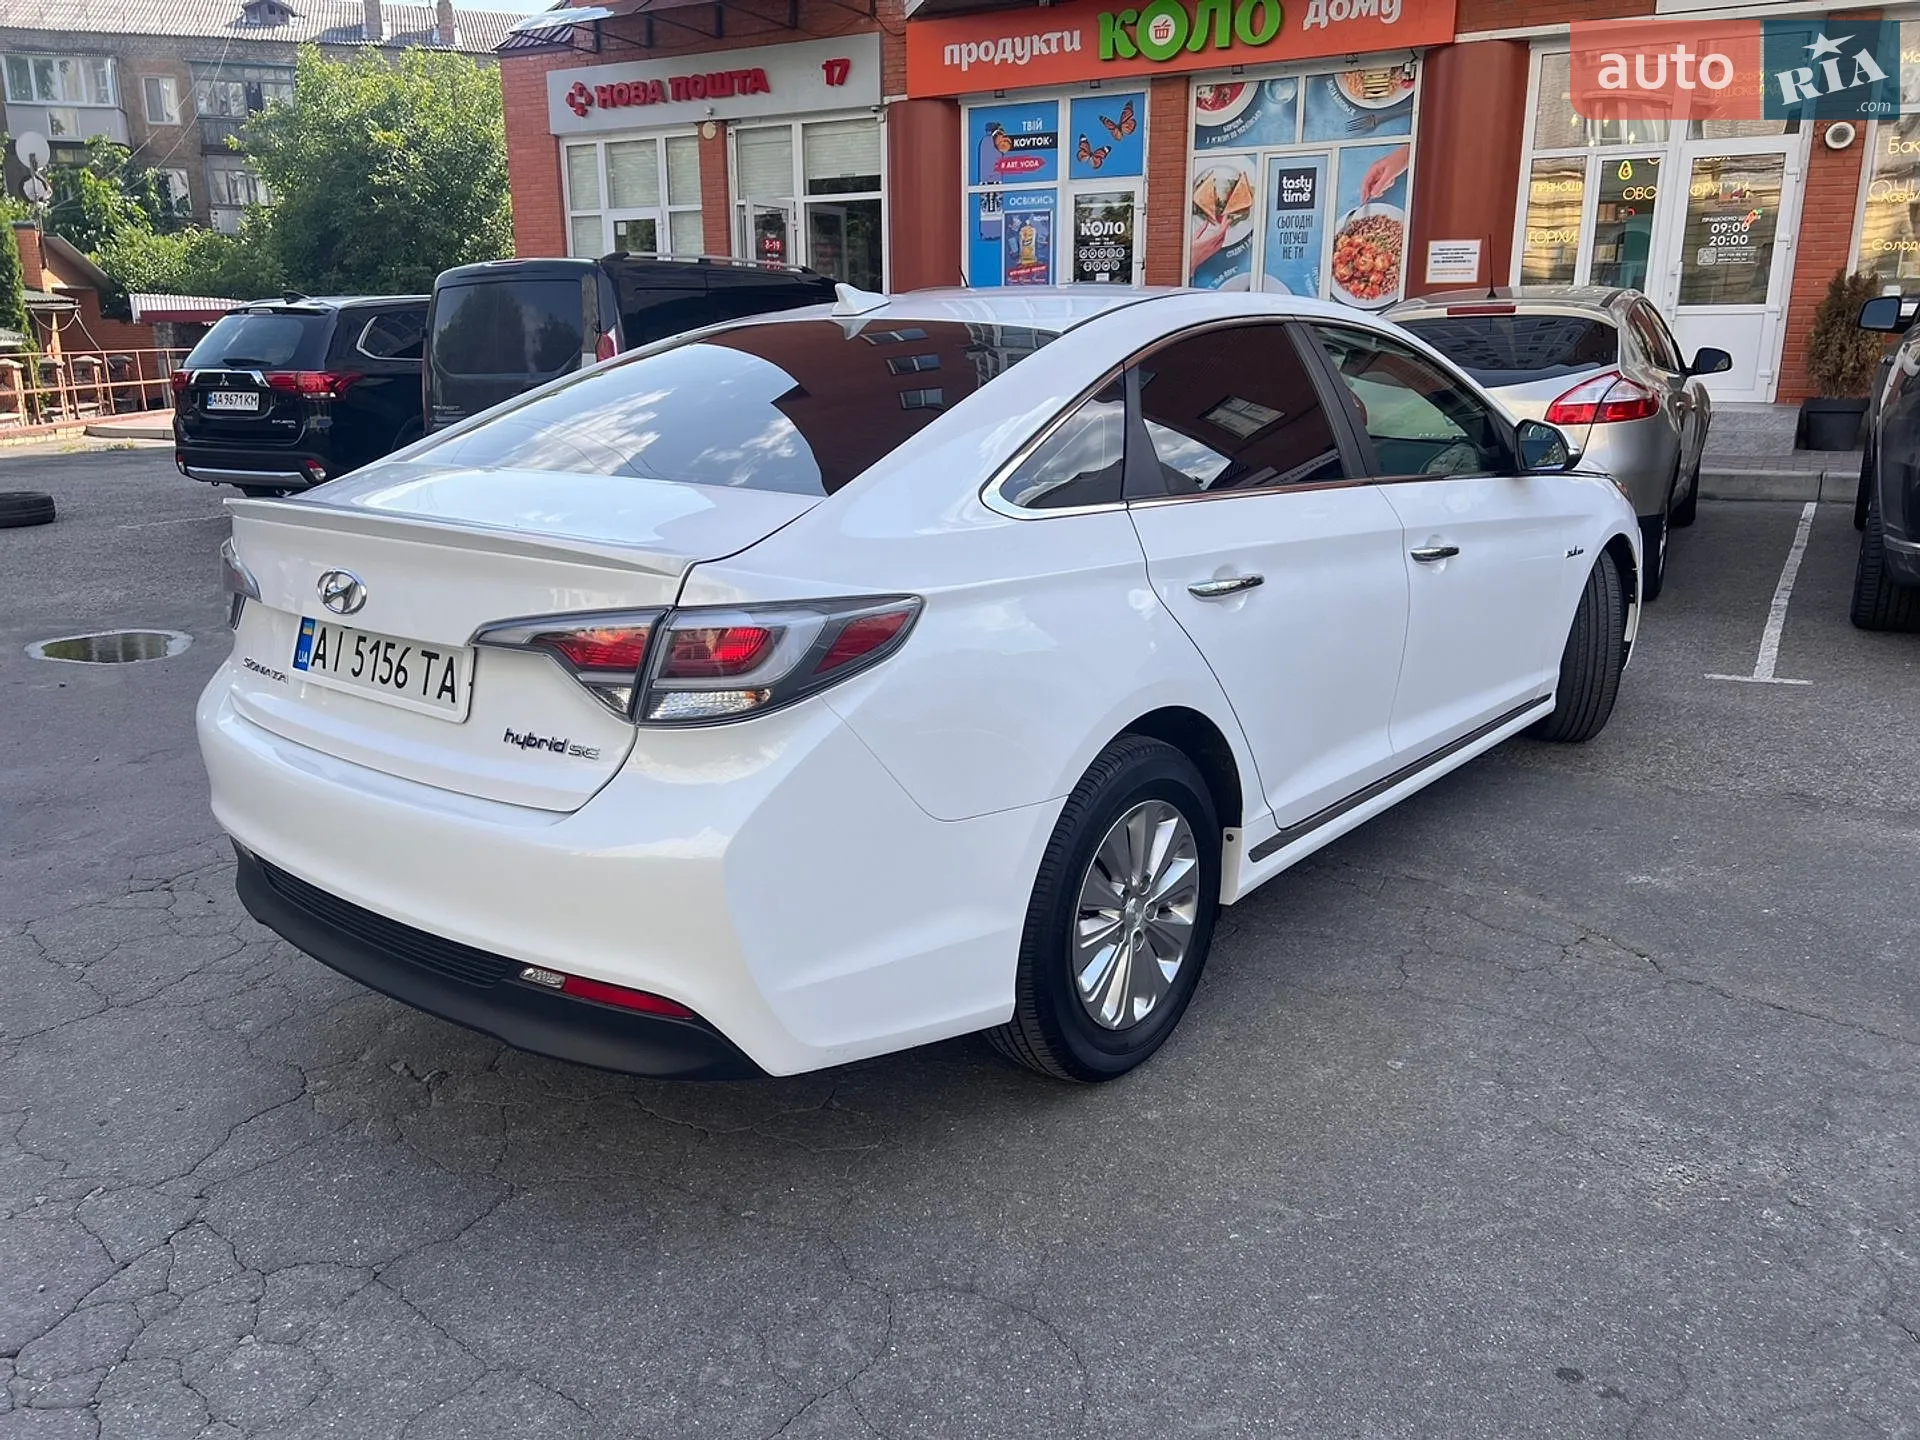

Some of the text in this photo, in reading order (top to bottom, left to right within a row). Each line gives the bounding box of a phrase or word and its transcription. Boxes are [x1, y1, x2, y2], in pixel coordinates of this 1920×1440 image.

[943, 30, 1082, 72] продукти
[1302, 0, 1401, 30] дому
[595, 58, 850, 109] НОВА ПОШТА 17
[1022, 117, 1043, 132] ТВІЙ
[1282, 174, 1313, 192] tasty
[1282, 189, 1311, 203] time
[1080, 221, 1126, 236] КОЛО
[1277, 214, 1314, 229] СЬОГОДНІ
[1710, 221, 1750, 234] 09:00
[1279, 231, 1309, 245] ГОТУЄШ
[1709, 235, 1749, 247] 20:00
[1282, 246, 1304, 260] НЕ ТИ
[242, 657, 289, 685] SONATA
[311, 627, 457, 703] AI 5156 TA
[503, 727, 569, 755] hybrid
